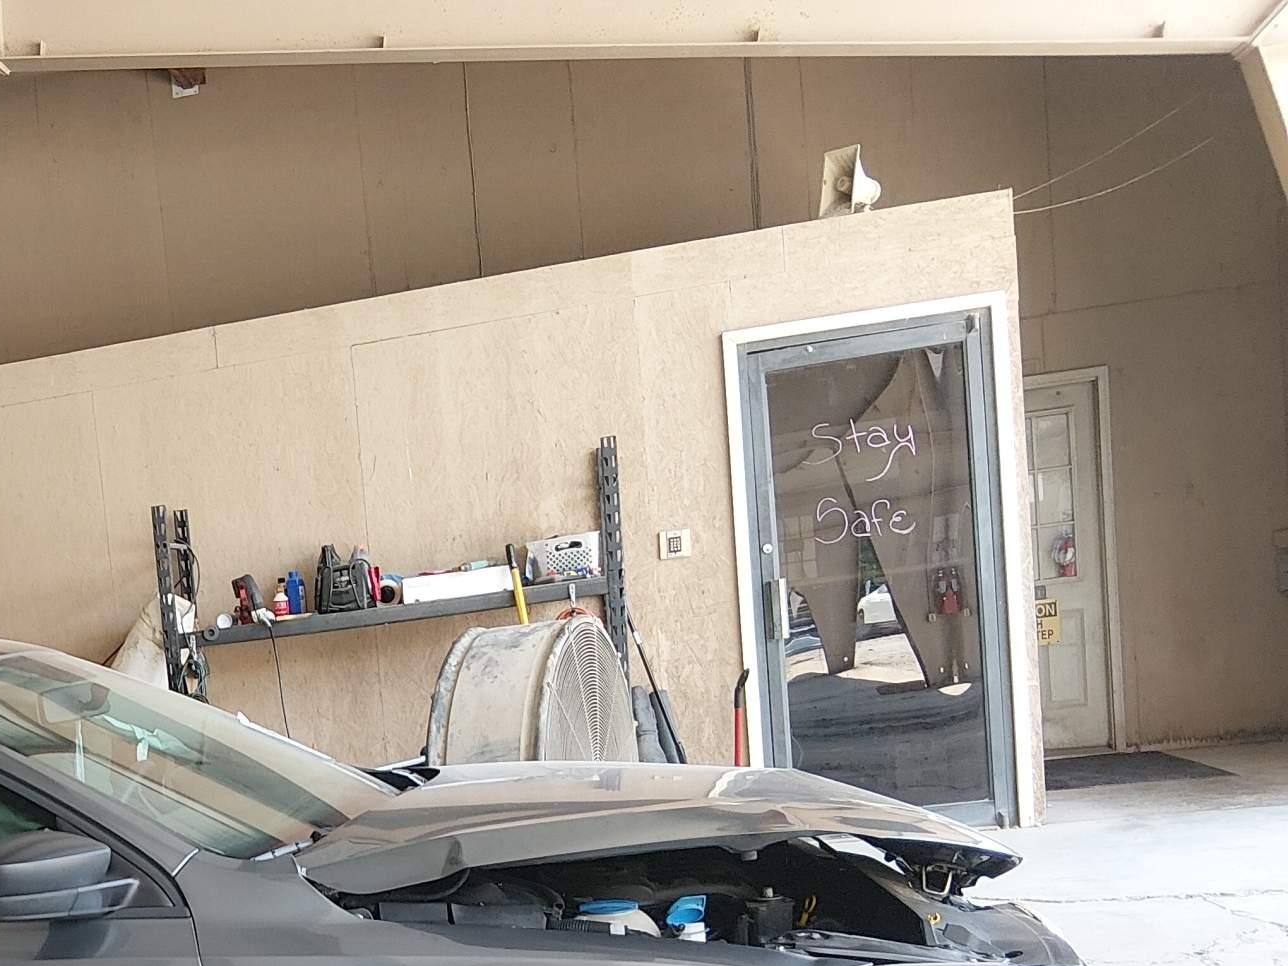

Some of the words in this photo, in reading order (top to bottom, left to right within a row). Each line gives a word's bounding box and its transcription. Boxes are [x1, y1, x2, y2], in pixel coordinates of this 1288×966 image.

[802, 418, 916, 482] Stay
[814, 496, 917, 545] Safe
[1036, 603, 1055, 616] ON
[1037, 629, 1054, 640] TEP
